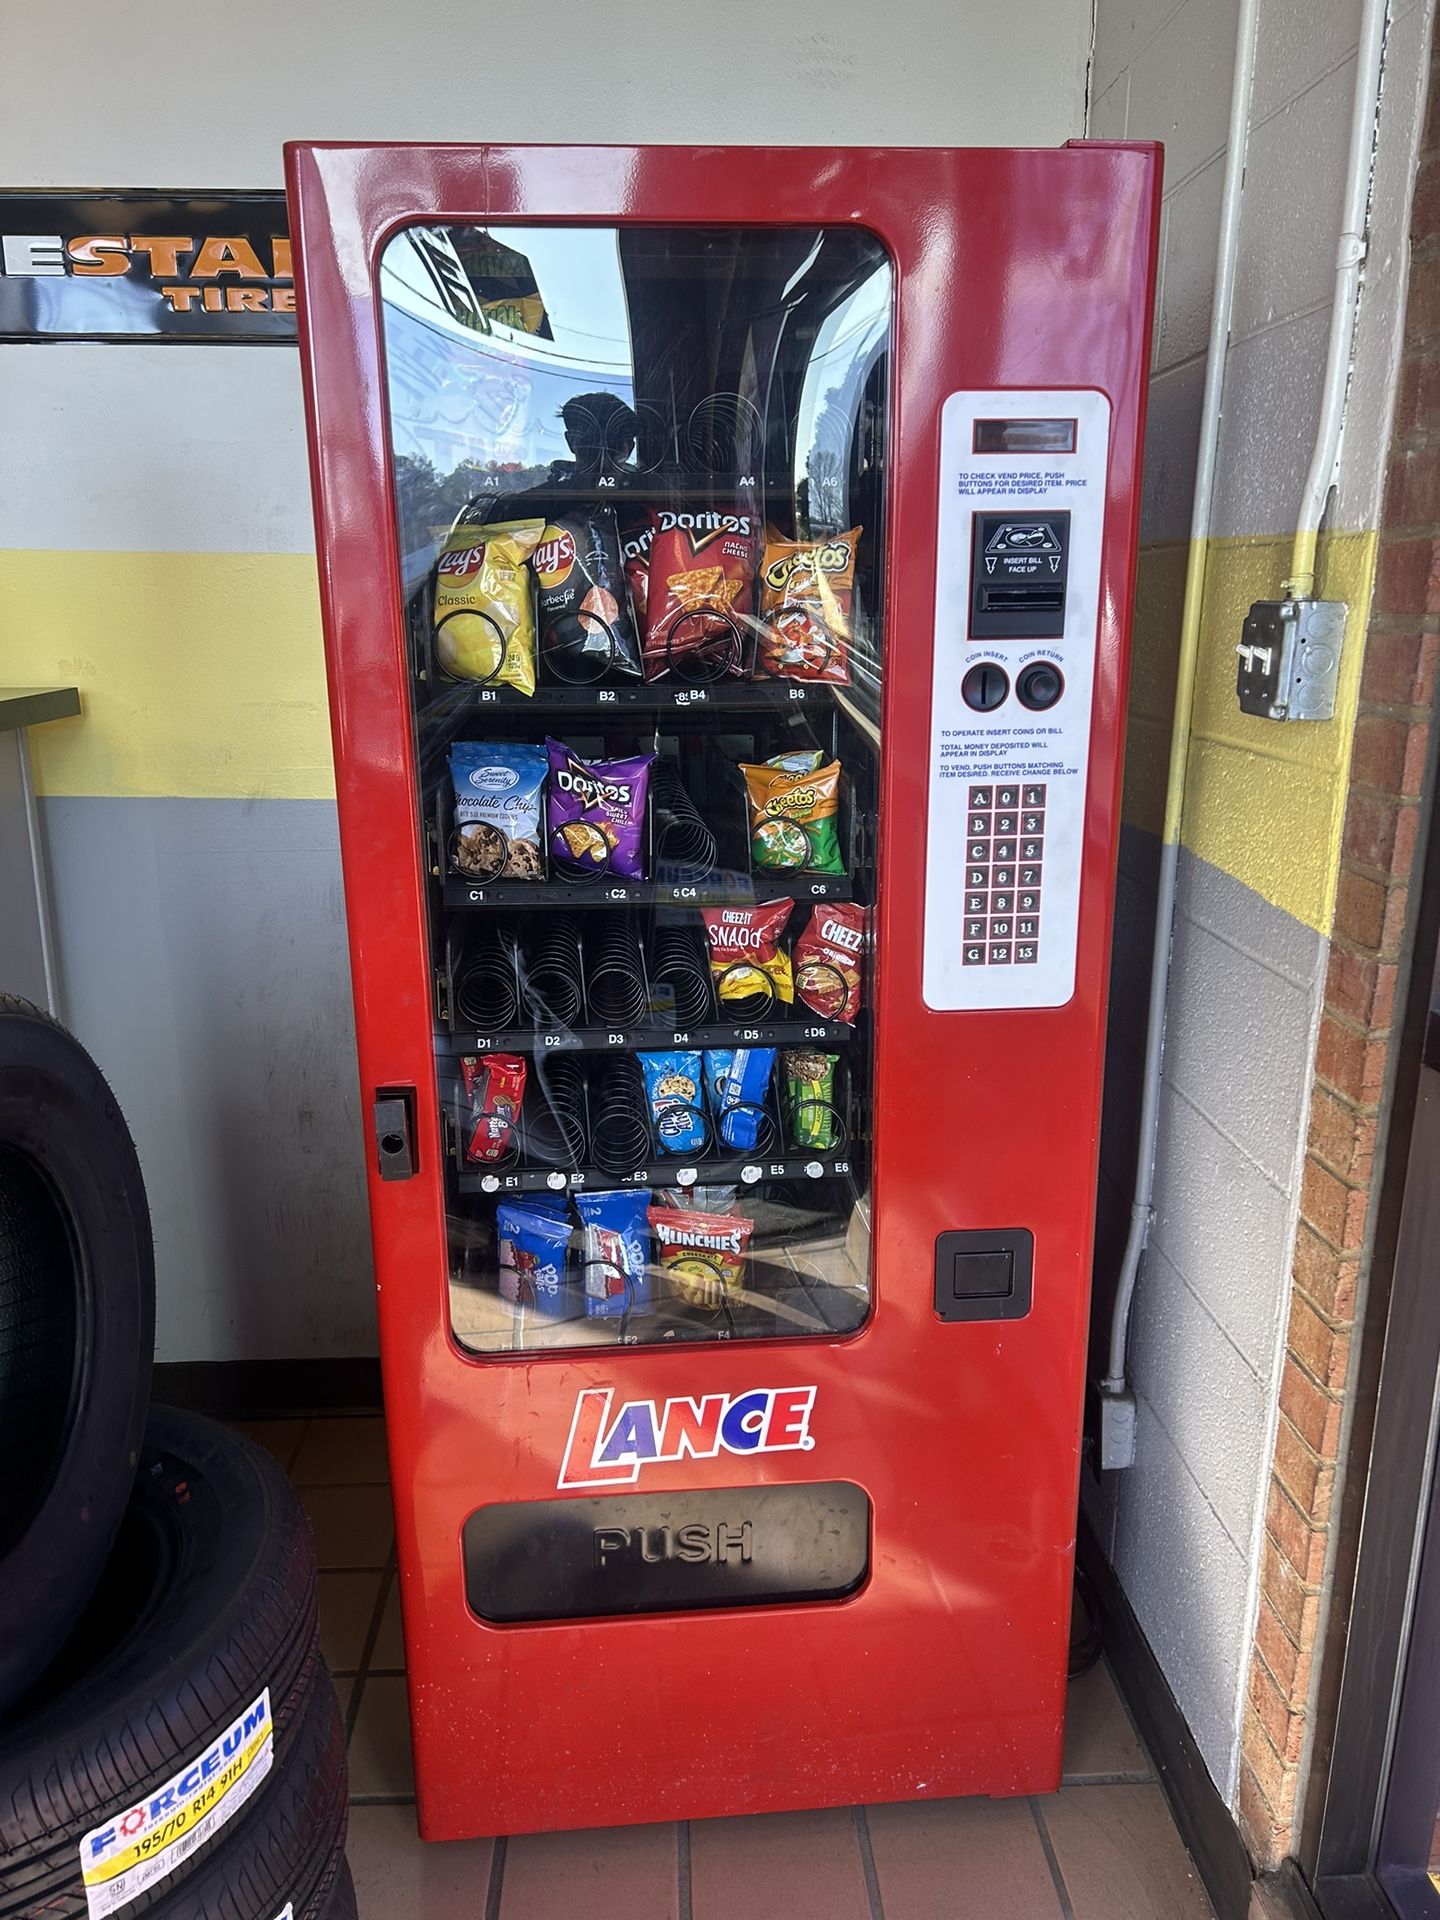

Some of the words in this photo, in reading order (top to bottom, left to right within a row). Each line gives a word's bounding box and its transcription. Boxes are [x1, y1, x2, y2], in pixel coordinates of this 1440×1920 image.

[959, 472, 968, 480] TO
[970, 472, 996, 480] CHECK
[998, 472, 1018, 480] VEND
[598, 477, 615, 487] A2
[739, 476, 755, 487] A4
[958, 487, 976, 495] WILL
[977, 487, 1007, 495] APPEAR
[1008, 487, 1016, 495] IN
[1017, 487, 1048, 495] DISPLAY
[657, 511, 750, 536] Doritos
[437, 545, 482, 576] Lay's
[1003, 557, 1027, 565] INSERT
[1028, 557, 1043, 565] BILL
[1027, 565, 1037, 573] UP
[437, 594, 476, 606] Classic
[965, 651, 983, 663] COIN
[983, 651, 1009, 663] INSERT
[1019, 650, 1036, 663] COIN
[1037, 649, 1065, 663] RETURN
[481, 691, 496, 700] B1
[600, 691, 615, 701] B2
[690, 690, 706, 699] B4
[789, 689, 805, 699] B6
[557, 771, 630, 802] Doritos
[766, 786, 816, 816] Cheetos
[974, 793, 986, 804] A
[1002, 792, 1010, 803] 0
[1029, 792, 1036, 803] 1
[974, 819, 984, 831] B
[1001, 819, 1009, 830] 2
[1027, 818, 1036, 829] 3
[972, 846, 983, 857] C
[999, 846, 1007, 857] 4
[1026, 845, 1035, 856] 5
[971, 872, 983, 883] D
[998, 872, 1007, 882] 6
[1024, 871, 1033, 881] 7
[611, 889, 626, 899] C2
[681, 888, 696, 897] C4
[811, 885, 826, 894] C6
[469, 891, 484, 900] C1
[970, 898, 982, 909] E
[997, 897, 1006, 908] 8
[1023, 897, 1032, 907] 9
[970, 924, 981, 935] F
[993, 923, 1008, 933] 10
[1020, 922, 1033, 932] 11
[968, 949, 979, 960] G
[992, 948, 1007, 959] 12
[1018, 947, 1033, 958] 13
[744, 1030, 759, 1039] D5
[810, 1028, 826, 1037] D6
[545, 1036, 560, 1046] D2
[608, 1034, 624, 1044] D3
[673, 1033, 689, 1043] D4
[477, 1039, 491, 1048] D1
[488, 1116, 501, 1139] Nutte
[771, 1165, 785, 1174] E5
[835, 1163, 848, 1172] E6
[506, 1176, 518, 1186] E1
[570, 1174, 585, 1183] E2
[634, 1171, 647, 1181] E3
[656, 1223, 742, 1254] MUNCHIES
[624, 1336, 638, 1344] F2
[718, 1331, 730, 1339] F4
[556, 1385, 817, 1490] LANCE
[592, 1520, 753, 1569] PUSH
[133, 1814, 187, 1858] 195/70
[192, 1786, 216, 1815] R14
[220, 1757, 244, 1790] 91H
